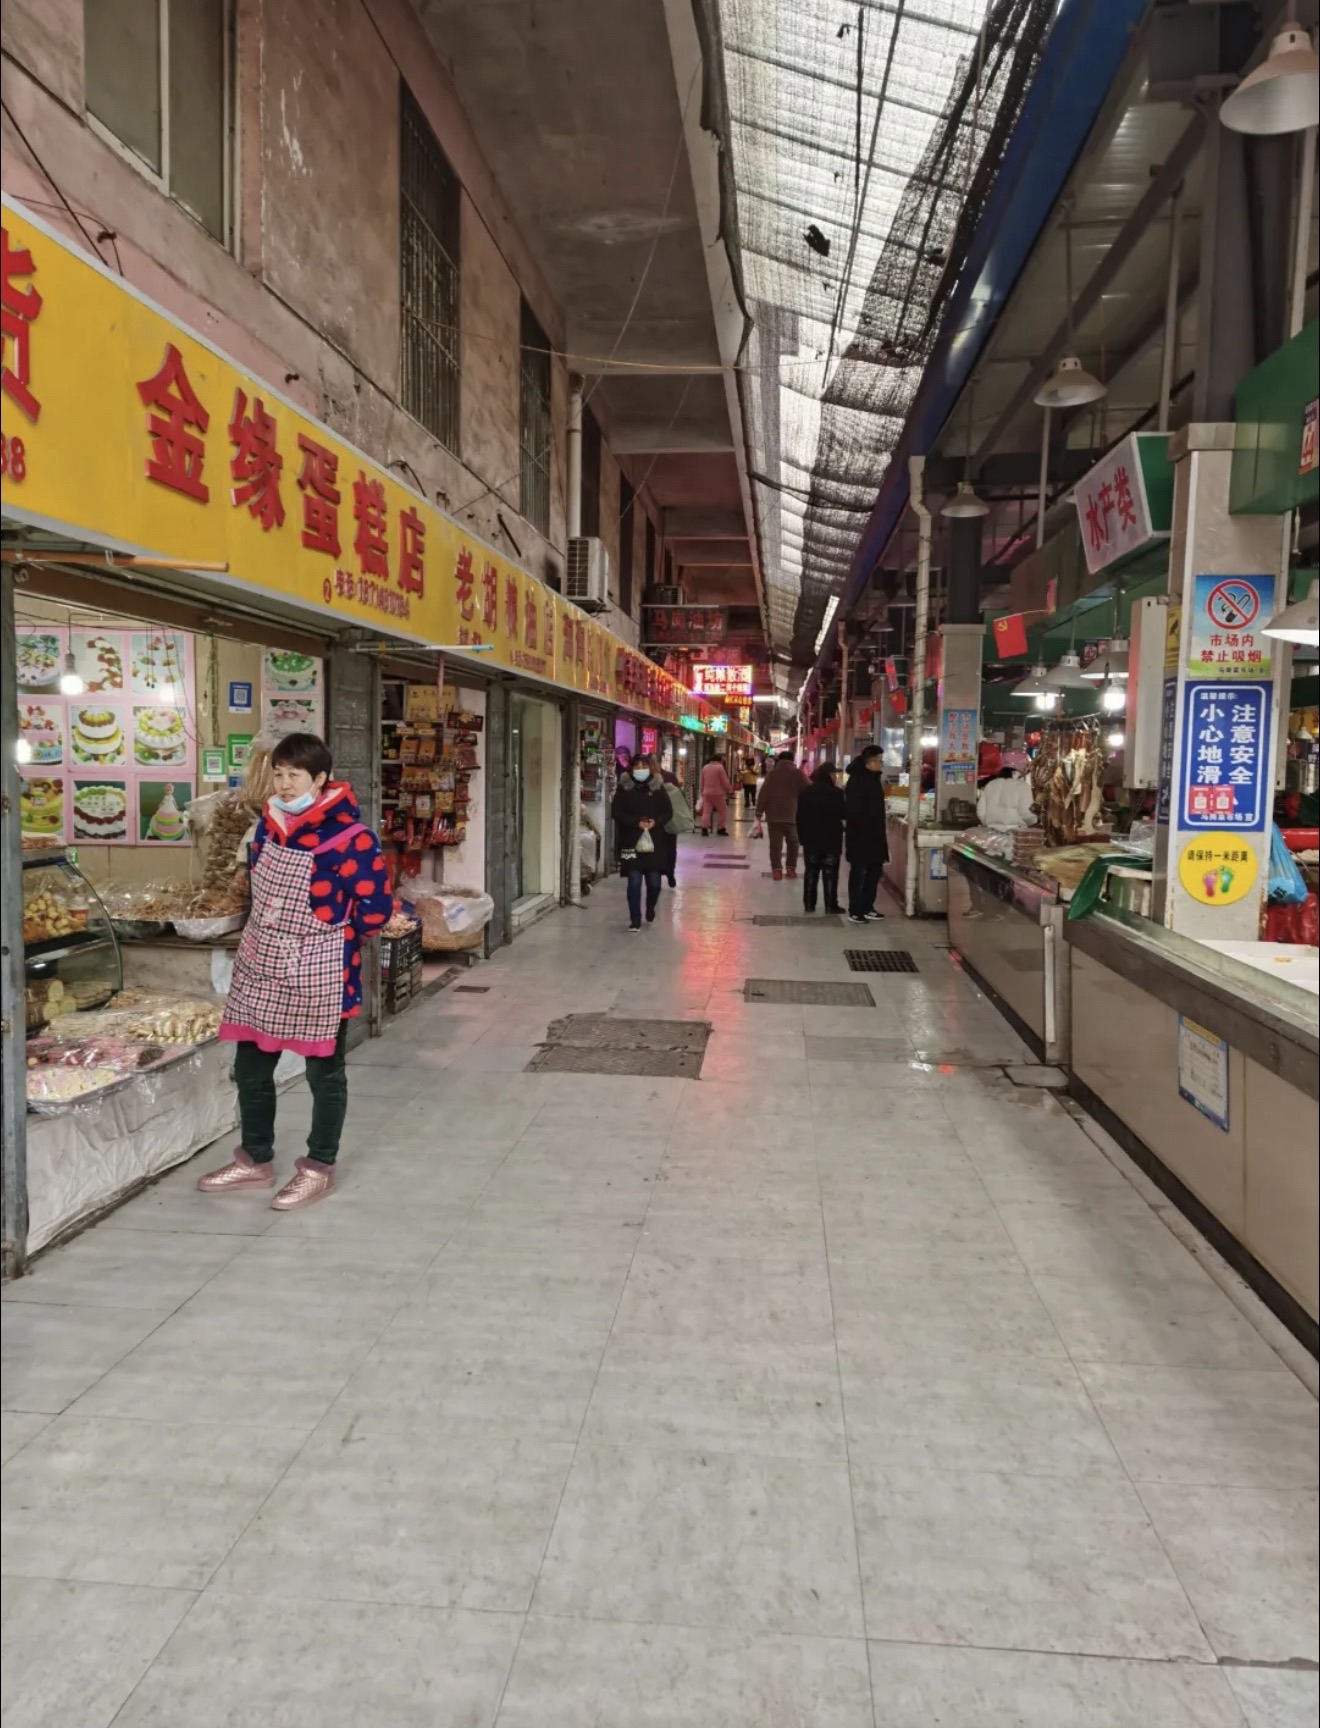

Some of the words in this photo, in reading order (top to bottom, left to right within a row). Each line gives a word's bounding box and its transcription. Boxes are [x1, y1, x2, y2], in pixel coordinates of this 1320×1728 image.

[136, 341, 426, 599] 金缘蛋糕店
[1085, 465, 1137, 551] 水产类
[1200, 649, 1263, 664] 禁止吸烟
[1210, 633, 1255, 648] 市场内
[1197, 703, 1225, 785] 小心地滑
[1229, 703, 1257, 785] 注意安全
[1187, 849, 1249, 862] 请保持一米距离
